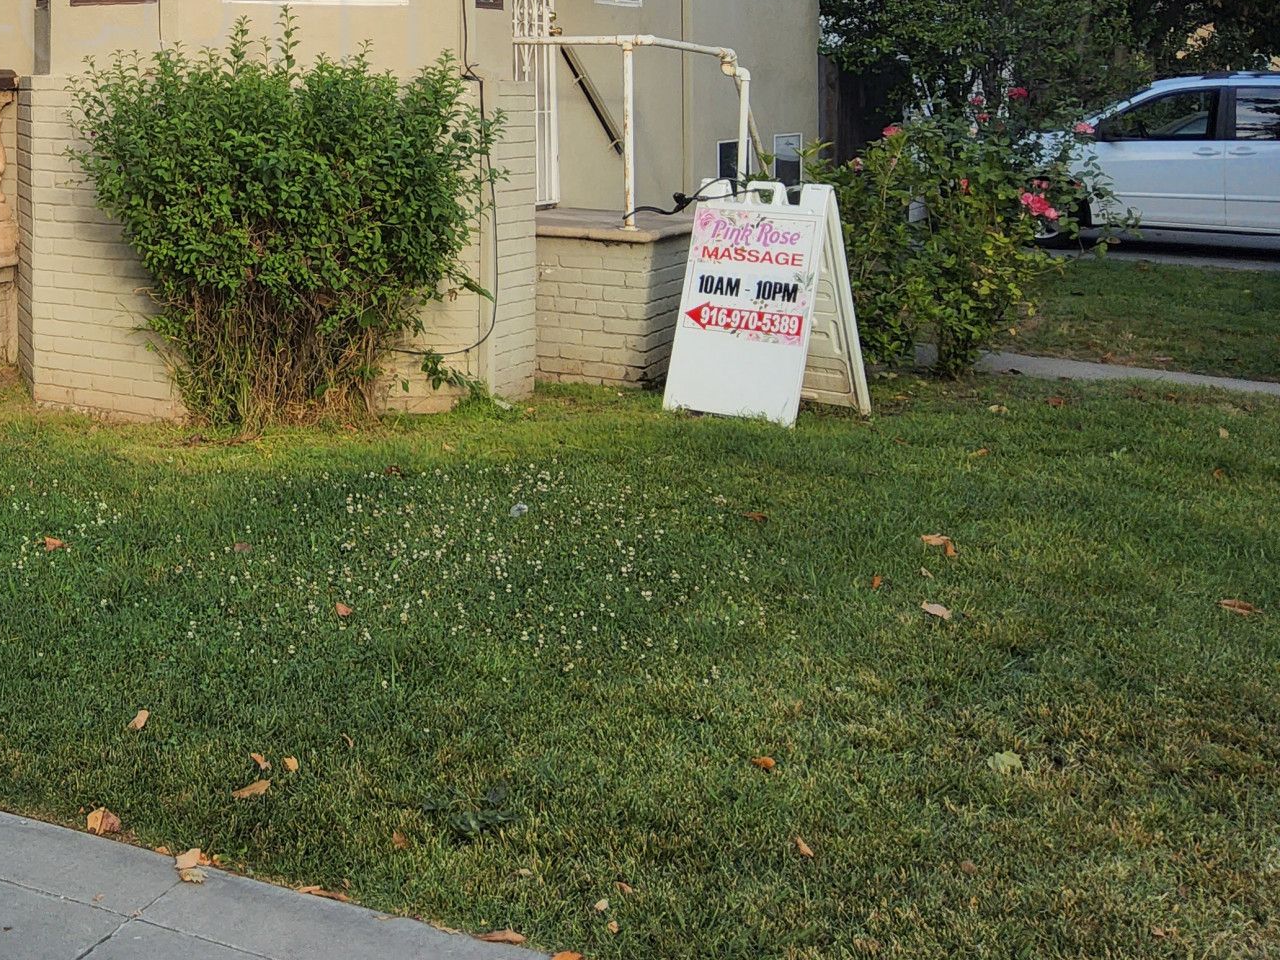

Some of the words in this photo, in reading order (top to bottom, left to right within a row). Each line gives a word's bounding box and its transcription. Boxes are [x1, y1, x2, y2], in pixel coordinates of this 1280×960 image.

[710, 218, 753, 246] Pink
[755, 222, 801, 247] Rose
[702, 245, 804, 267] MASSAGE
[698, 274, 741, 298] 10AM
[755, 280, 799, 303] 10PM
[700, 305, 799, 335] 916-970-5389
